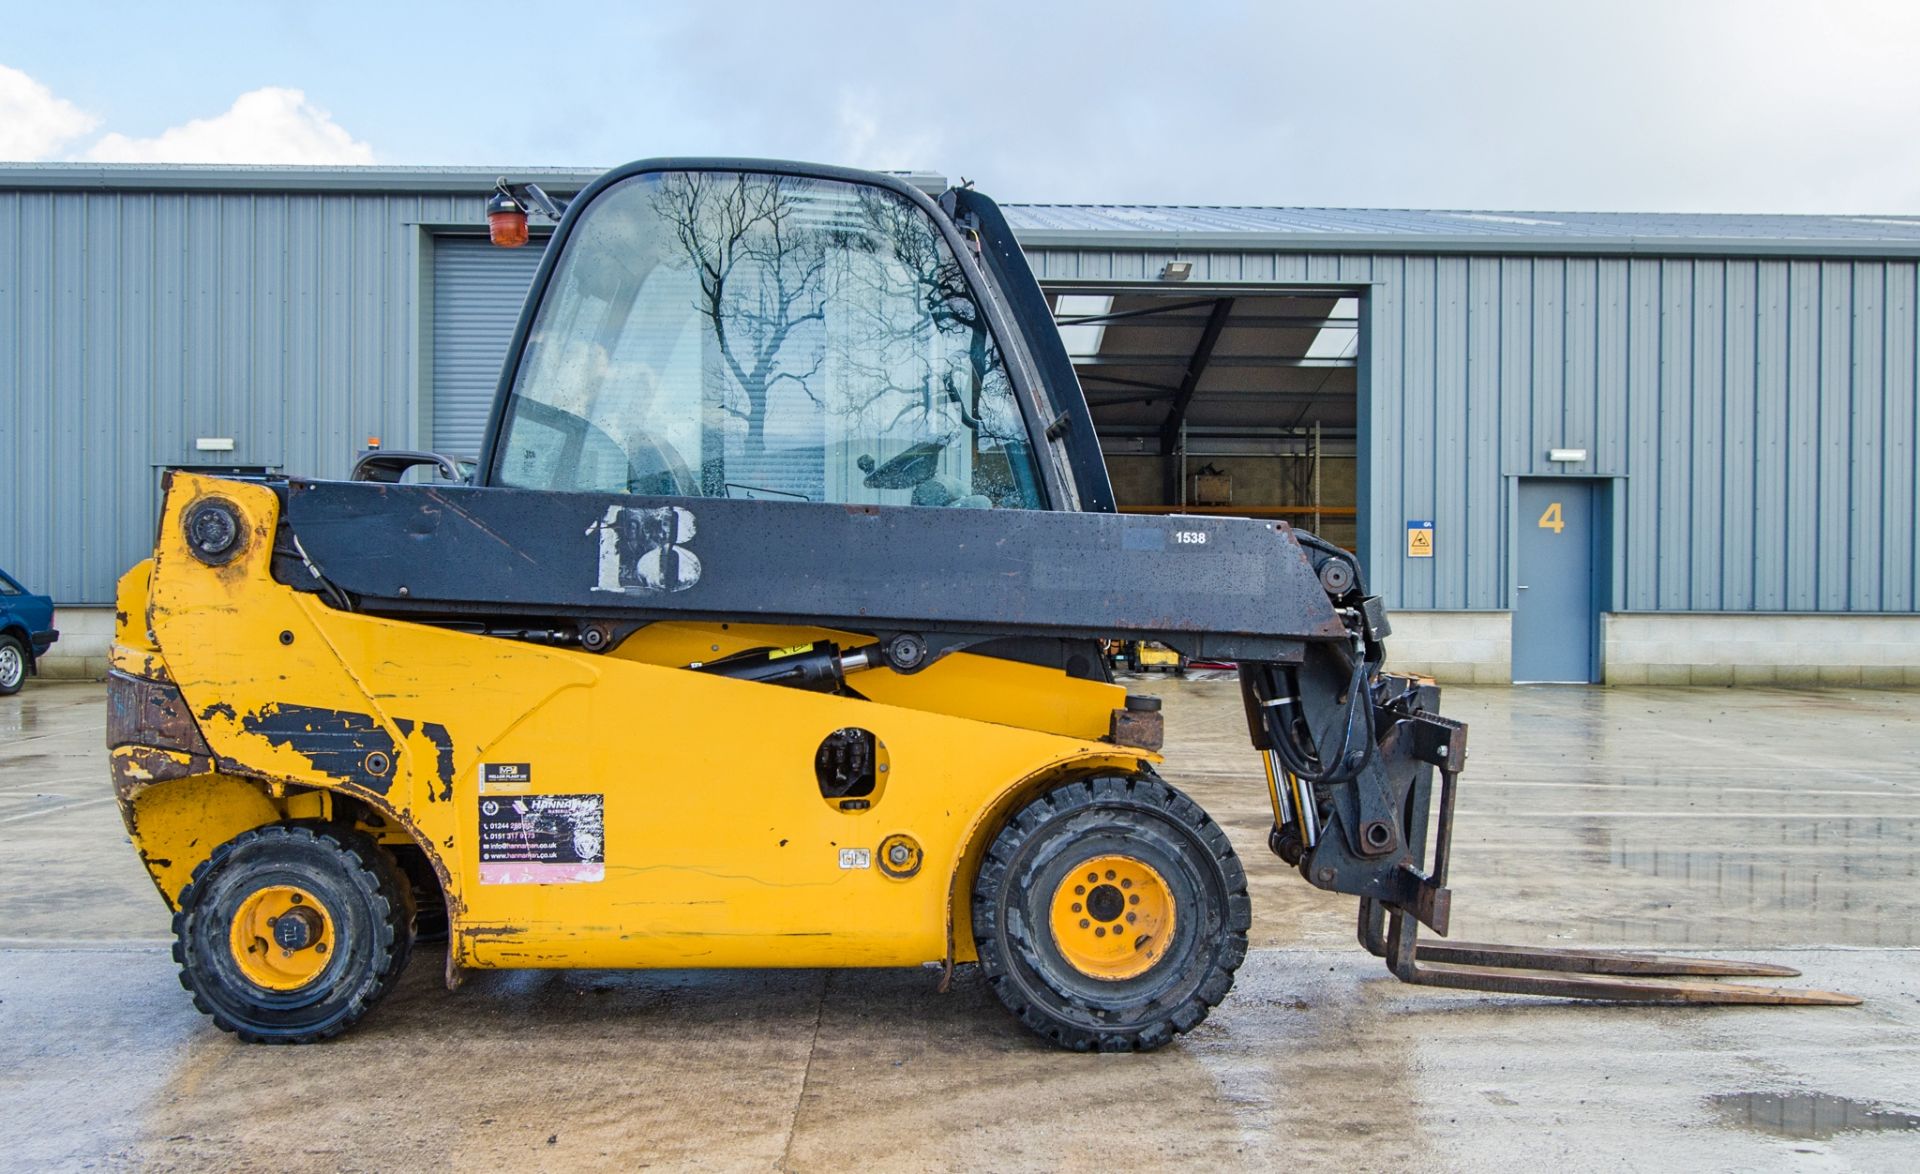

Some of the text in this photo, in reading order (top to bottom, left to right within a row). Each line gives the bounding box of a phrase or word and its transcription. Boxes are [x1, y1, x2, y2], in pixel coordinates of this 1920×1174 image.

[1538, 502, 1565, 534] 4
[1175, 531, 1206, 544] 1538
[531, 800, 597, 810] HANNA
[489, 832, 505, 840] 0151
